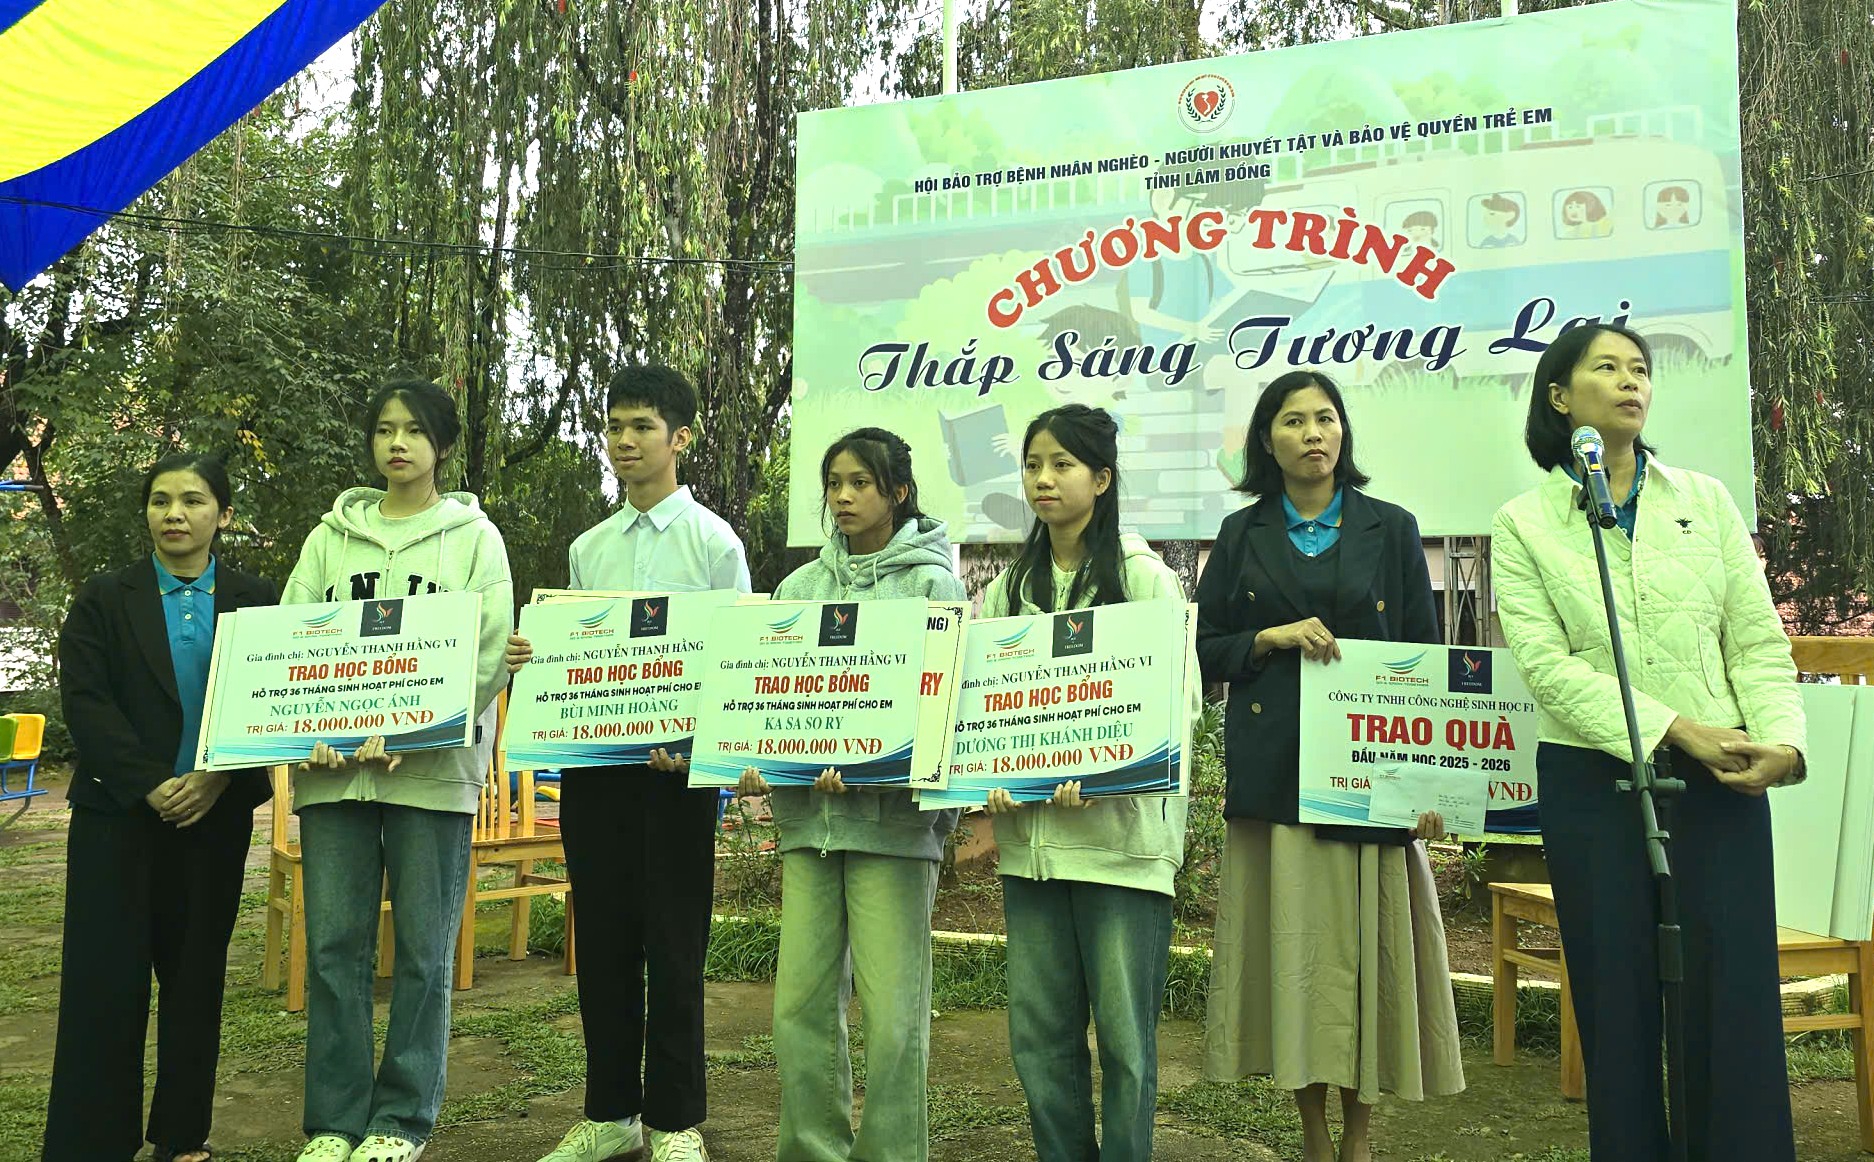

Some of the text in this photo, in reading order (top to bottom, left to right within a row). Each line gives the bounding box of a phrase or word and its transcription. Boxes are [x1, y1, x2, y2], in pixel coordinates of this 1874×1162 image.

[914, 107, 1552, 194] HỘI BẢO TRỢ BỆNH NHÂN NGHÈO NGƯỜI KHUYẾT TẬT VÀ BẢO VỆ QUYỀN TRẺ EM
[1144, 161, 1271, 190] TỈNH LÂM ĐỒNG
[987, 207, 1456, 329] CHƯƠNG TRÌNH
[859, 316, 1467, 397] Thắp Sáng Tương
[246, 637, 457, 662] Gia đình chị: NGUYỄN THANH HẰNG VI
[530, 638, 704, 665] Gia đình chị: NGUYỄN THANH HẰNG
[720, 649, 907, 670] Gia đình chị: NGUYỄN THANH HẰNG VI
[999, 648, 1035, 658] BIOTECH
[288, 652, 418, 682] TRAO HỌC BỔNG
[566, 654, 684, 685] TRAO HỌC BỔNG
[961, 655, 1152, 690] đình chị: NGUYỄN THANH HẰNG VI
[1389, 676, 1429, 684] BIOTECH
[251, 677, 444, 699] HỖ TRỢ 36 THÁNG SINH HOẠT PHÍ CHO EM
[535, 682, 693, 703] HỖ TRỢ 36 THÁNG SINH HOẠT PHÍ CHO
[754, 666, 870, 698] TRAO HỌC BỔNG
[984, 674, 1113, 713] TRAO HỌC BỔNG
[269, 693, 421, 716] NGUYỄN NGỌC ÁNH
[560, 697, 679, 720] BÙI MINH HOÀNG
[722, 698, 893, 713] HỖ TRỢ 36 THÁNG SINH HOẠT PHÍ CHO EM
[1328, 689, 1535, 714] CÔNG TY TNHH CÔNG NGHỆ SINH HỌC F1
[246, 709, 434, 735] TRỊ GIÁ: 18.000.000 VNĐ
[532, 716, 697, 741] TRỊ GIÁ: 18.000.000 VNĐ
[764, 716, 844, 731] KA SA SO RY
[966, 702, 1142, 733] TRỢ 36 THÁNG SINH HOẠT PHÍ CHO EM
[955, 719, 1134, 756] DƯƠNG THỊ KHÁNH DIỆU
[1346, 713, 1516, 752] TRAO QUÀ
[717, 738, 883, 755] TRỊ GIÁ: 18.000.000 VNĐ
[949, 743, 1134, 776] TRỊ GIÁ: 18.000.000 VNĐ
[1439, 755, 1469, 769] 2025
[1481, 757, 1511, 772] 2026
[1329, 776, 1348, 790] TRỊ
[1487, 780, 1533, 802] VNĐ
